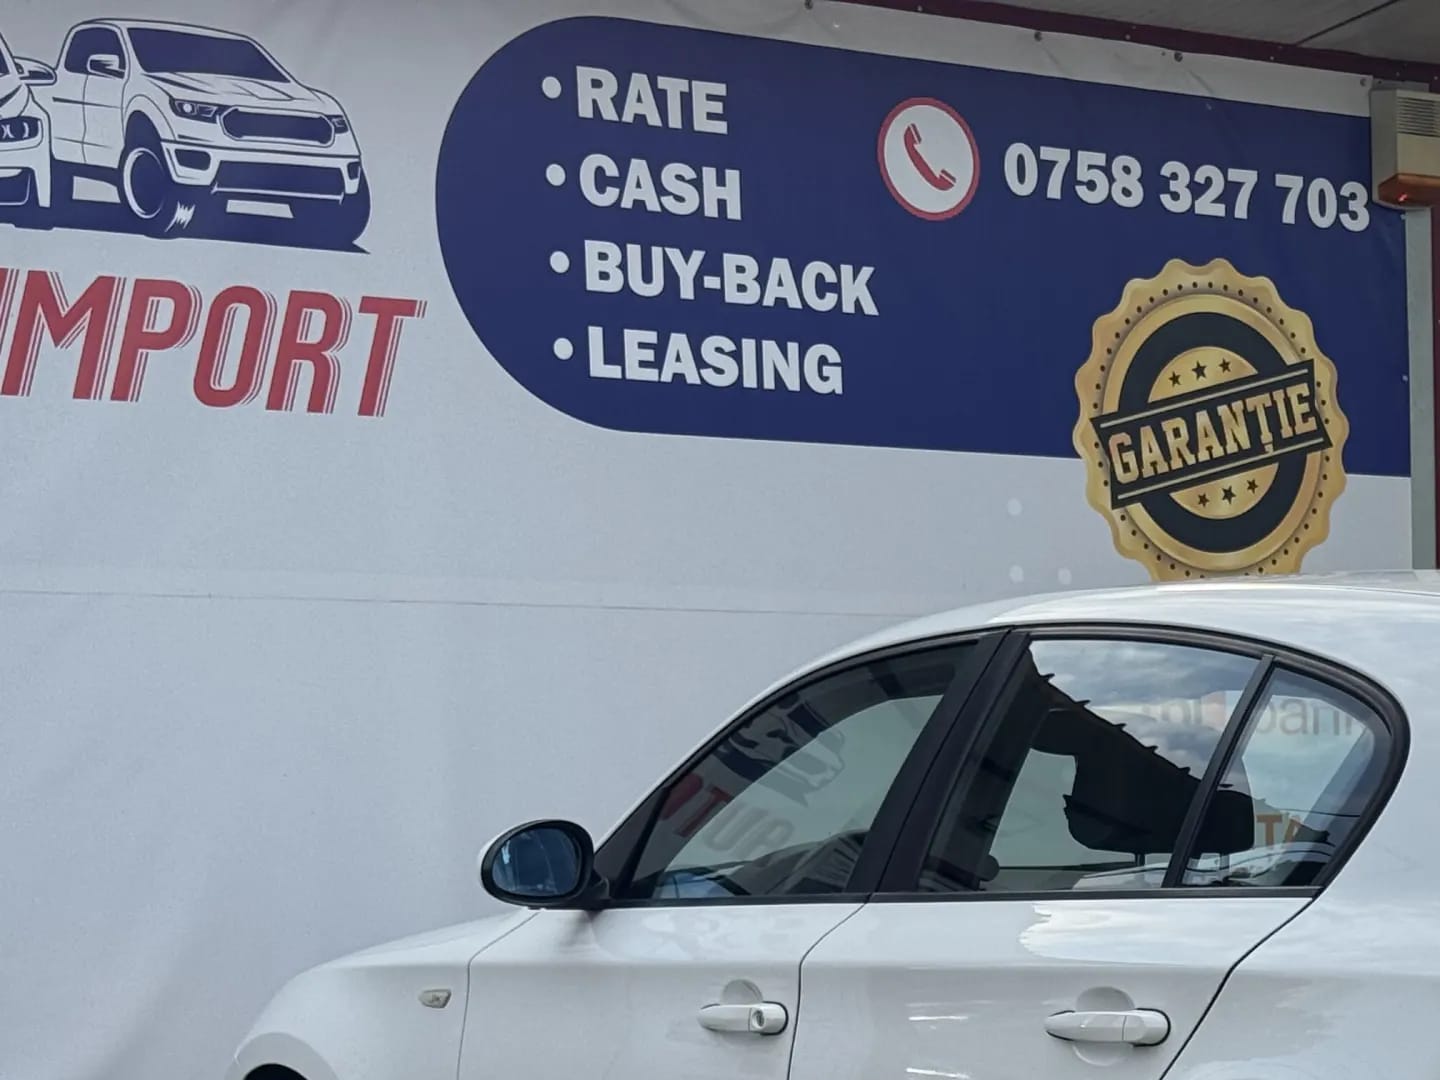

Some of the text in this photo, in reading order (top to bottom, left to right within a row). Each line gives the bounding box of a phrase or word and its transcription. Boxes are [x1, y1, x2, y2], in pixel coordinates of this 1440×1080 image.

[575, 65, 729, 136] RATE
[579, 153, 744, 222] CASH
[1003, 142, 1371, 233] 0758 327 703
[584, 239, 880, 317] BUY-BACK
[587, 325, 844, 395] LEASING
[1108, 382, 1319, 486] GARANȚIE
